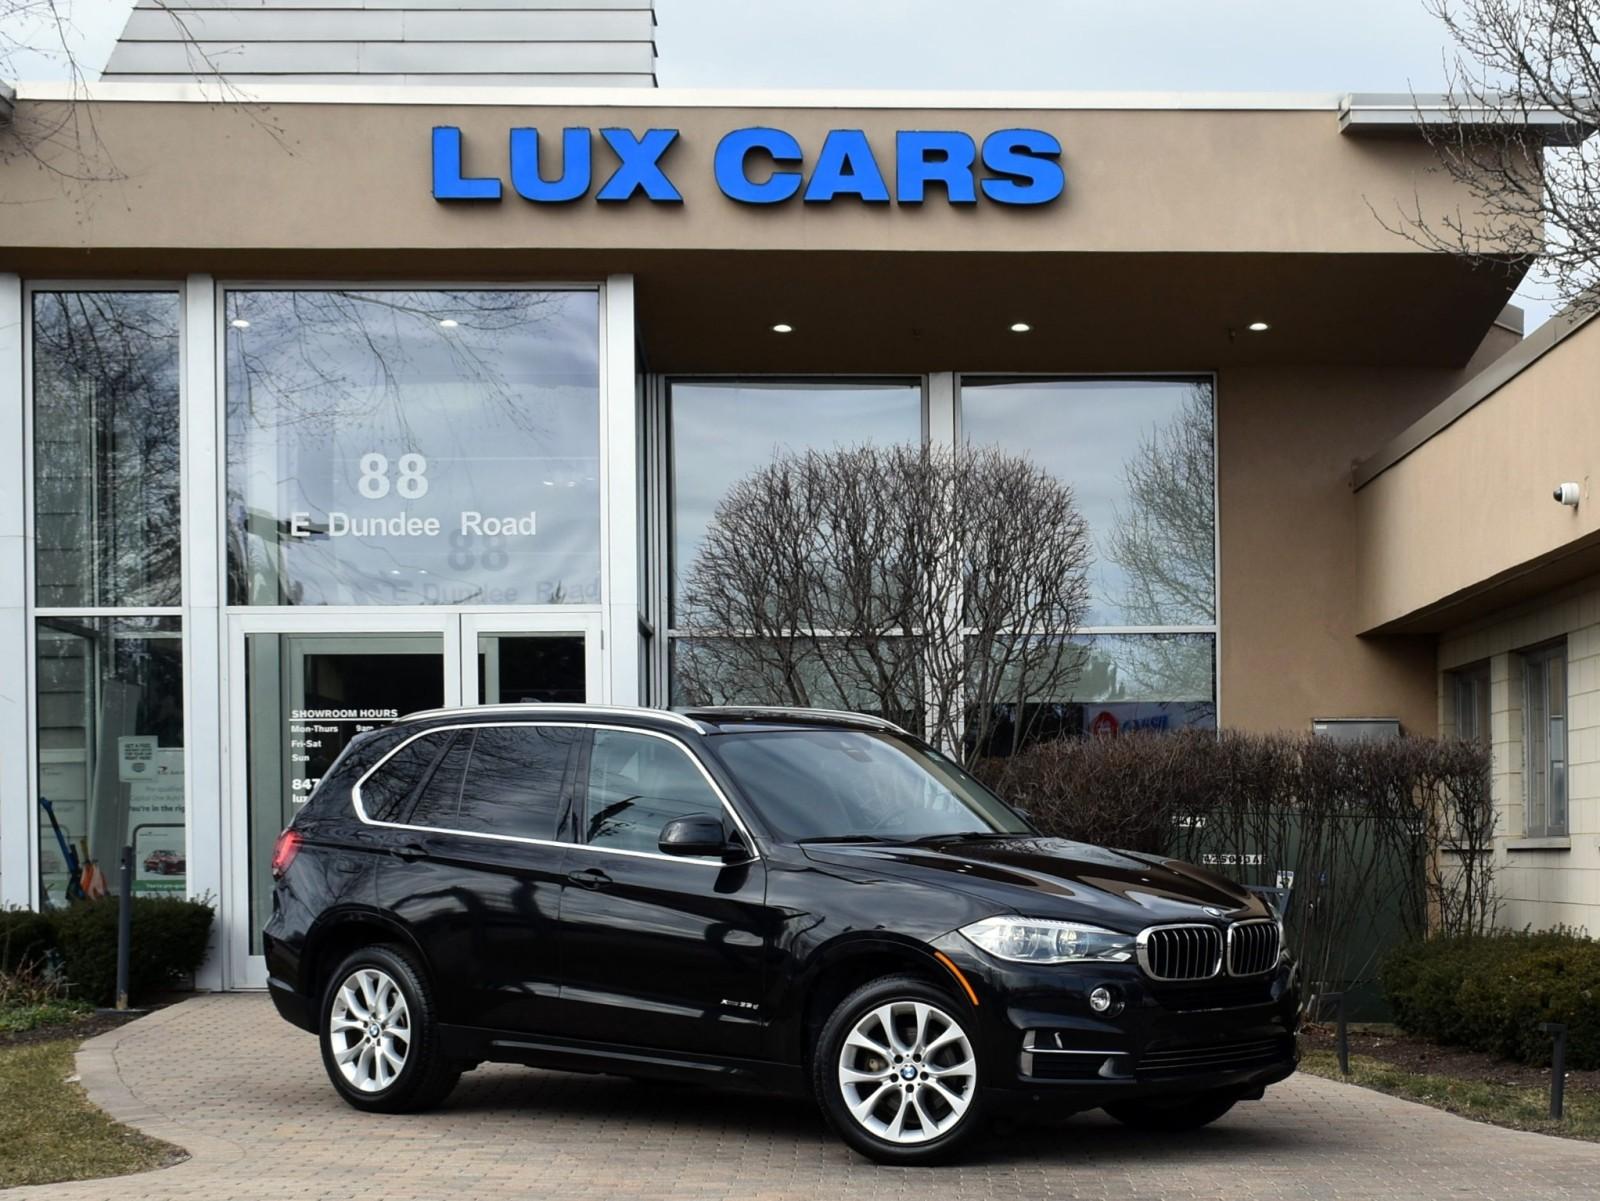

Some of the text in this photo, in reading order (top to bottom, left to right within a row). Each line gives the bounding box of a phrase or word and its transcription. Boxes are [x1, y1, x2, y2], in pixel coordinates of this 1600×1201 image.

[432, 126, 1065, 205] LUX CARS
[357, 452, 429, 500] 88
[290, 510, 537, 537] E Dundee Road
[447, 528, 510, 572] 88
[291, 709, 398, 719] SHOWROOM HOURS
[291, 725, 339, 733] Mon-Thurs
[291, 740, 322, 748] Fri-Sat
[291, 754, 310, 762] Sun
